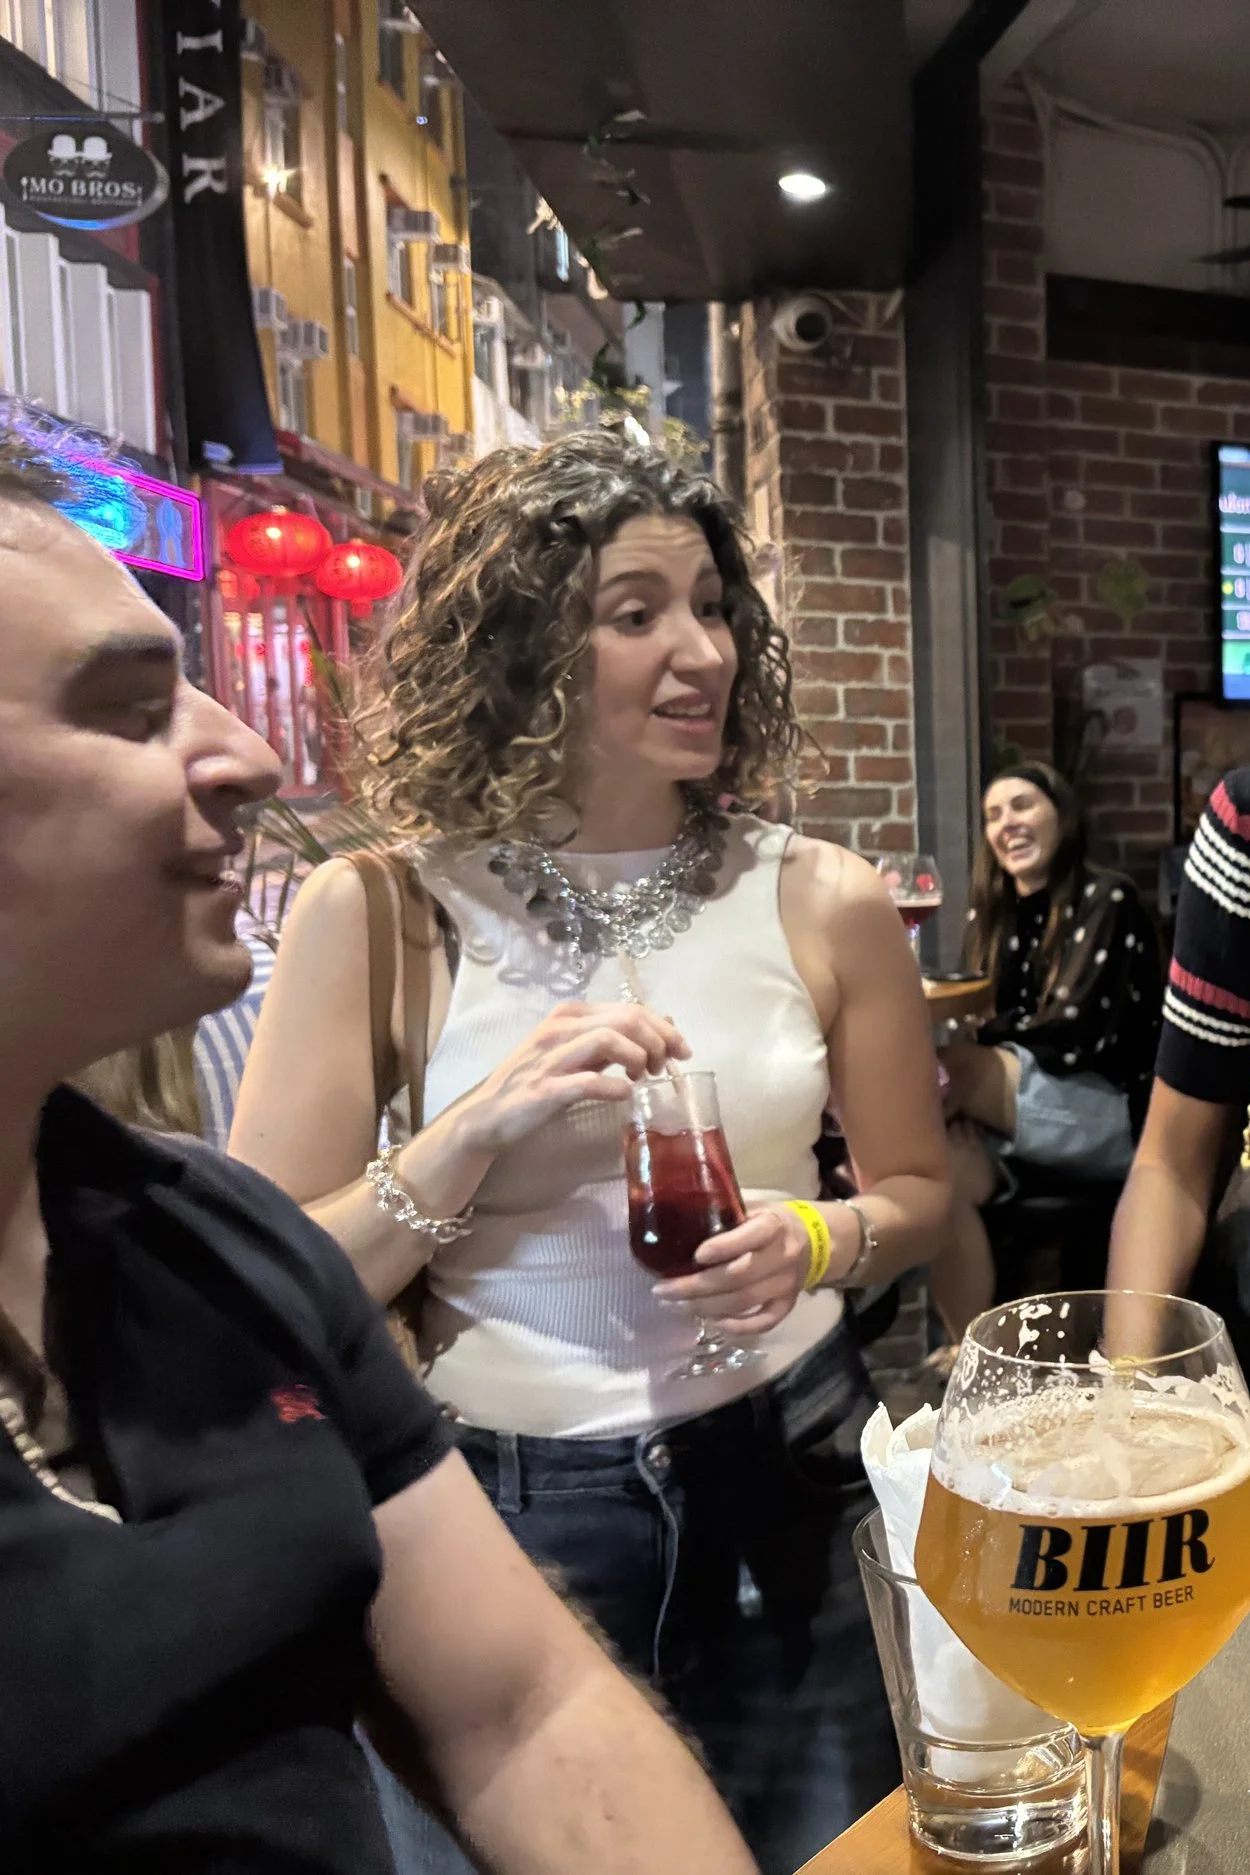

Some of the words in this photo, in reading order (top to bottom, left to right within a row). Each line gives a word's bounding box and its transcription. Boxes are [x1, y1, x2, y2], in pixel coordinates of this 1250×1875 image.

[176, 0, 228, 204] IAR
[29, 177, 64, 195] MO
[71, 179, 136, 198] BROS
[1010, 1508, 1215, 1592] BIIR
[1008, 1597, 1079, 1617] MODERN
[1086, 1595, 1147, 1616] CRAFT
[1153, 1585, 1194, 1609] BEER
